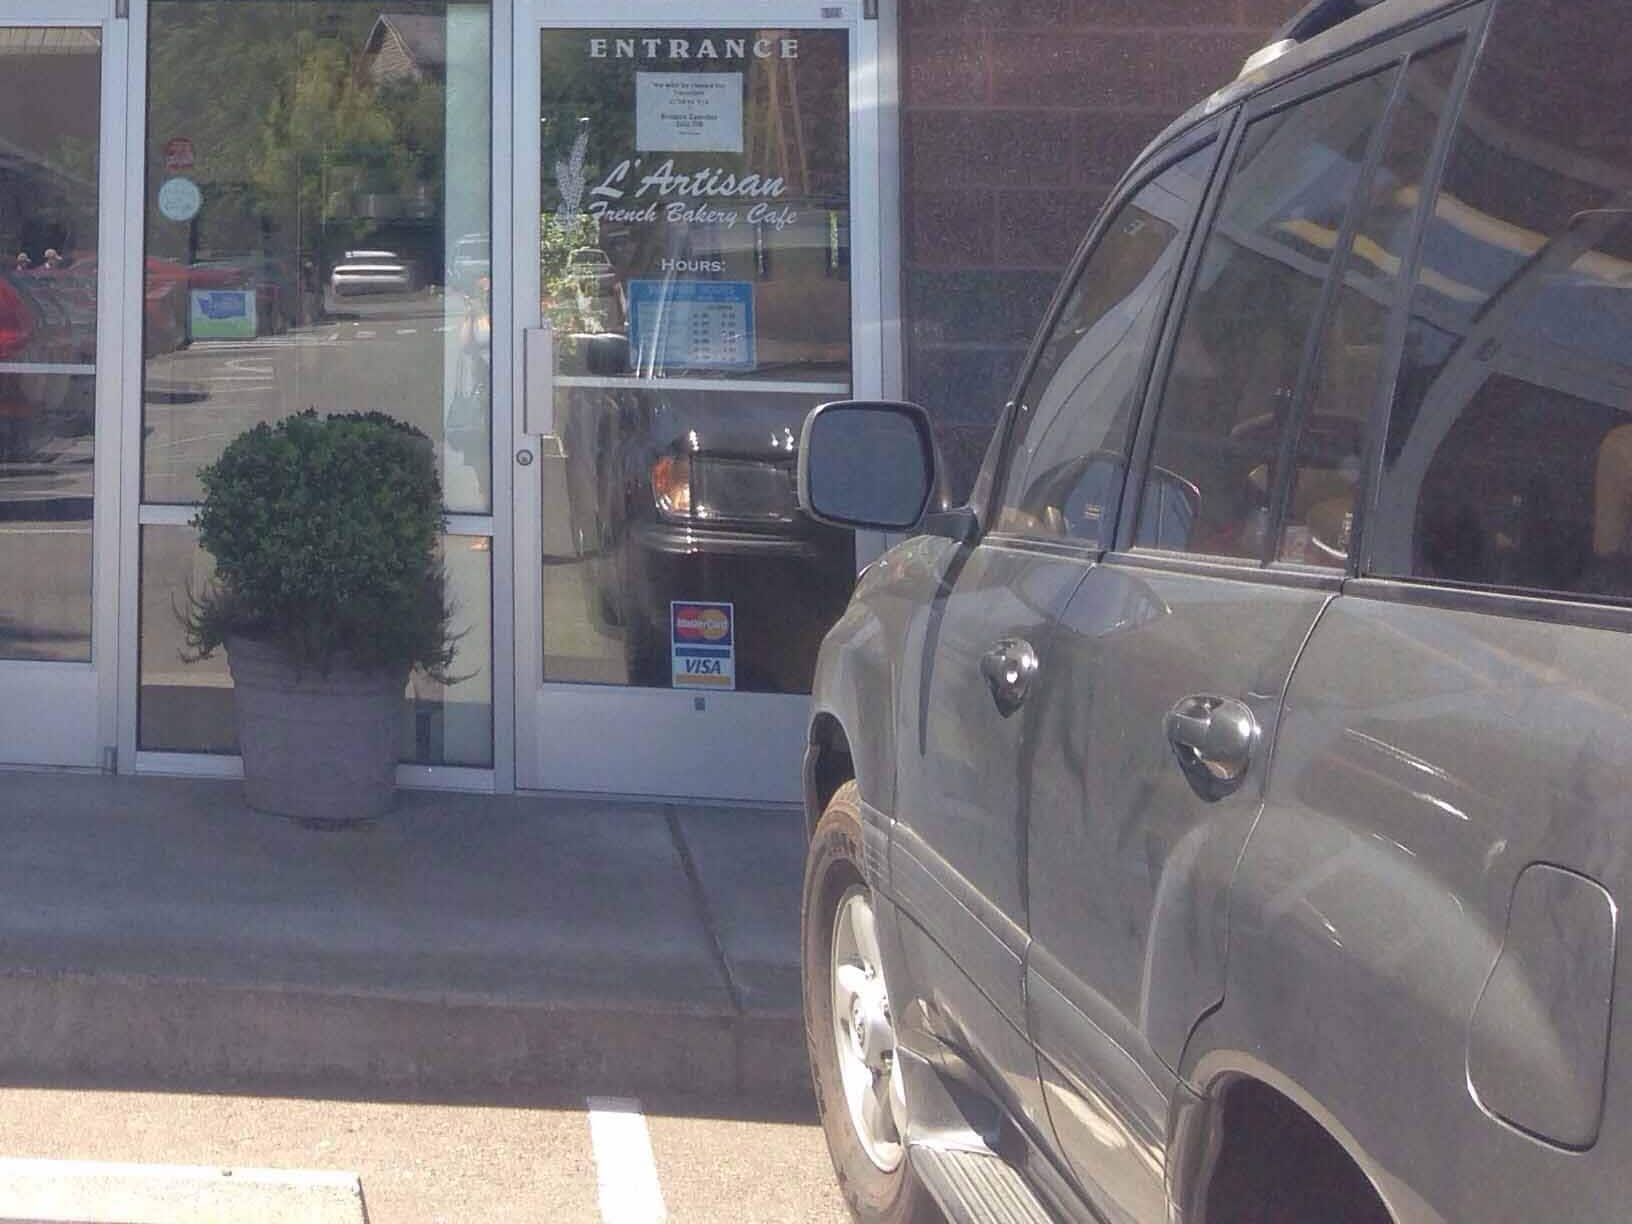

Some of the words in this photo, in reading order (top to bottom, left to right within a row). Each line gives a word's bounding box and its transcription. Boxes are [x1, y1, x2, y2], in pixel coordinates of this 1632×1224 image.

[589, 38, 800, 59] ENTRANCE
[587, 202, 657, 226] French
[665, 202, 738, 230] Bakery
[746, 202, 799, 231] Cafe
[685, 658, 722, 675] VISA
